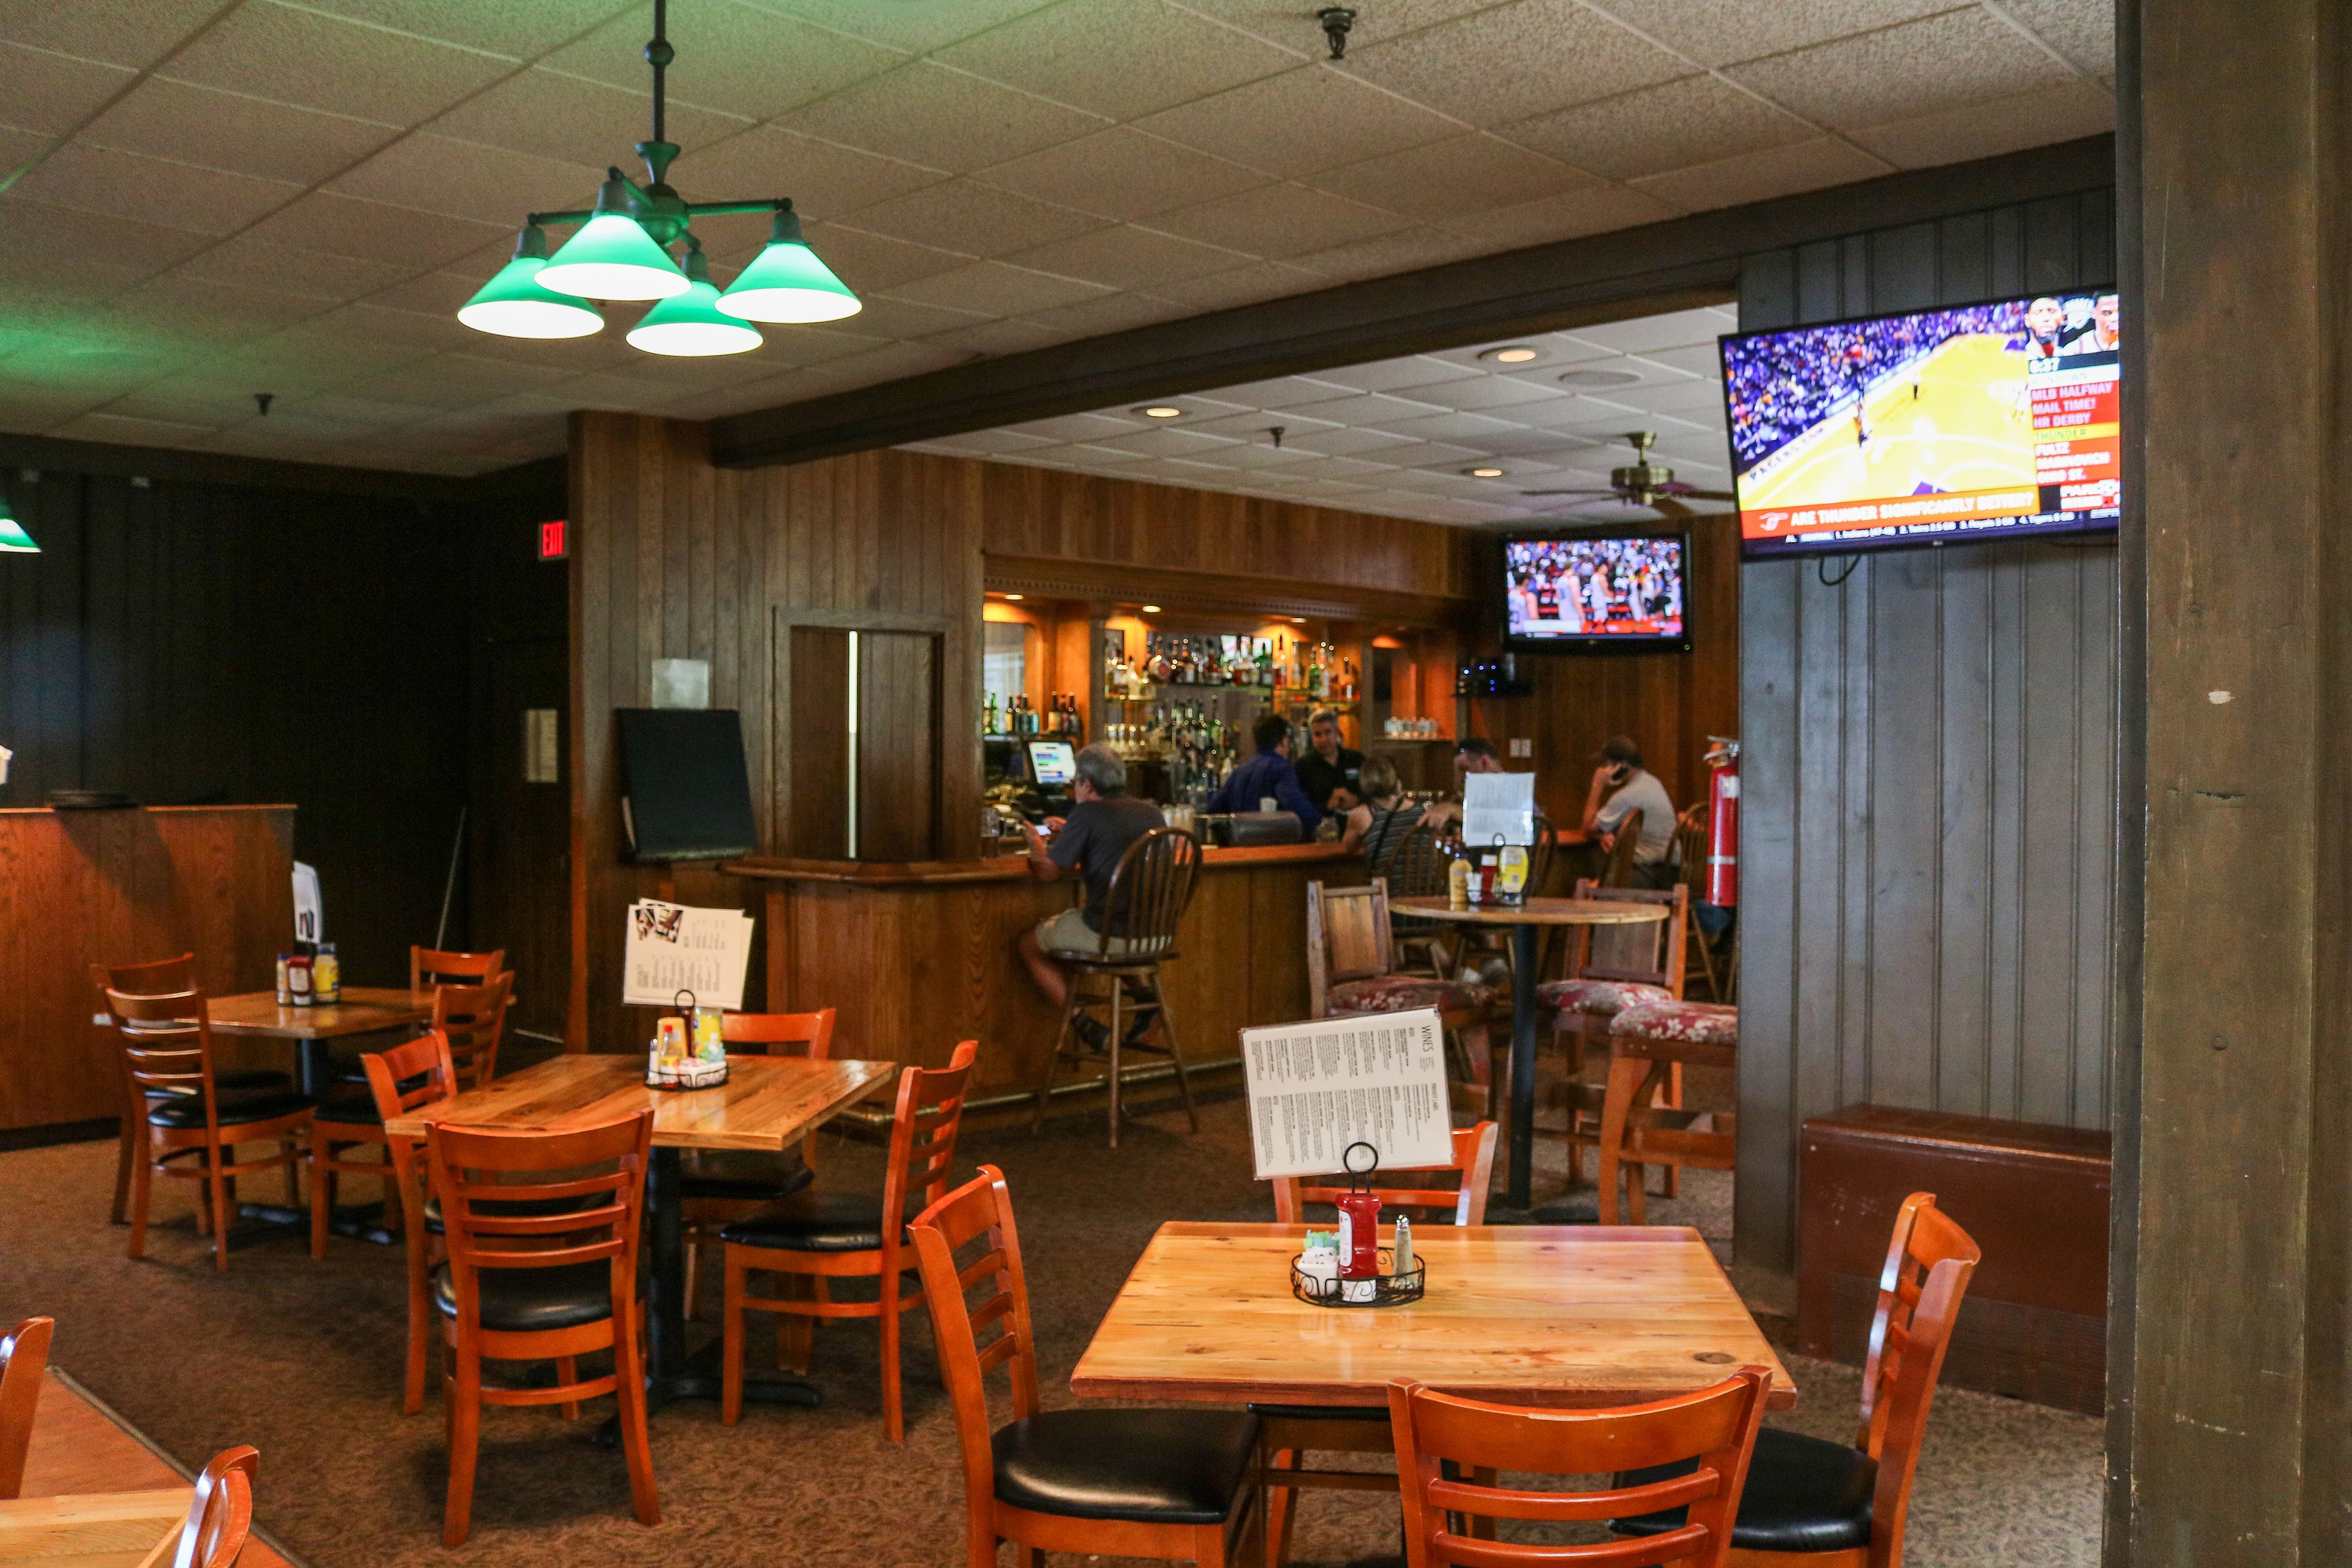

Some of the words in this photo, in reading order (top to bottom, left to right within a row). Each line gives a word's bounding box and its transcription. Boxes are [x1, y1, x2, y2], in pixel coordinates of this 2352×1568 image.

[2031, 389, 2057, 401] MLB
[2059, 382, 2113, 398] HALFWAY
[2032, 401, 2062, 415] MAIL
[2063, 398, 2096, 412] TIME!
[2034, 417, 2051, 429] HR
[2052, 412, 2091, 427] DERBY
[2035, 429, 2086, 441] THUNDER
[1790, 511, 1817, 526] ARE
[1817, 505, 1878, 524] THUNDER
[1879, 497, 1975, 519] SIGNIFICANTLY
[1977, 492, 2035, 511] BETTER?
[1421, 1025, 1434, 1052] WINES
